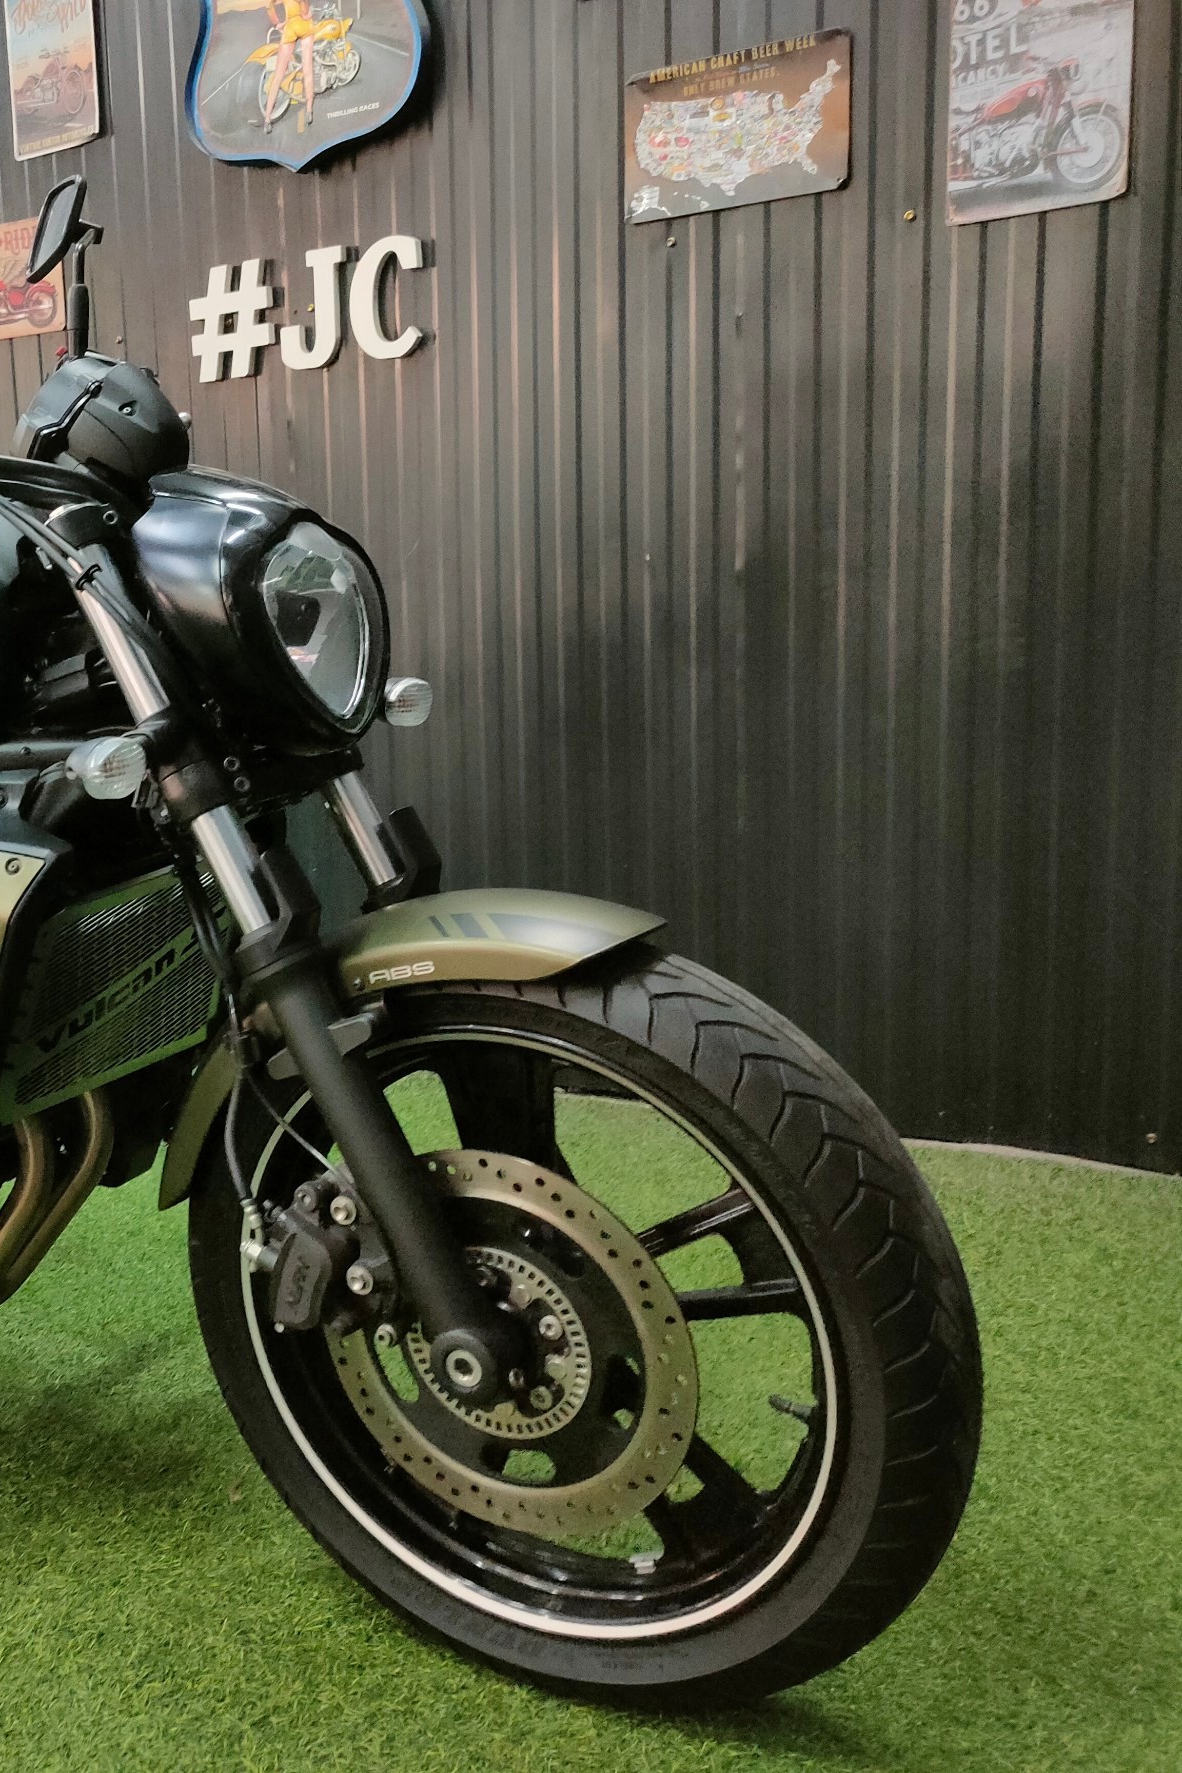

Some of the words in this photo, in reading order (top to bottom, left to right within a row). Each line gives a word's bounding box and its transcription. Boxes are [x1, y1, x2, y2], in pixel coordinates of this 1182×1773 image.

[649, 60, 707, 84] AMERICAN
[710, 50, 746, 70] CRAFT
[751, 42, 779, 60] BEER
[784, 32, 816, 53] WEEK
[359, 101, 380, 112] RACES
[189, 235, 424, 383] #JC
[369, 961, 435, 984] ABS
